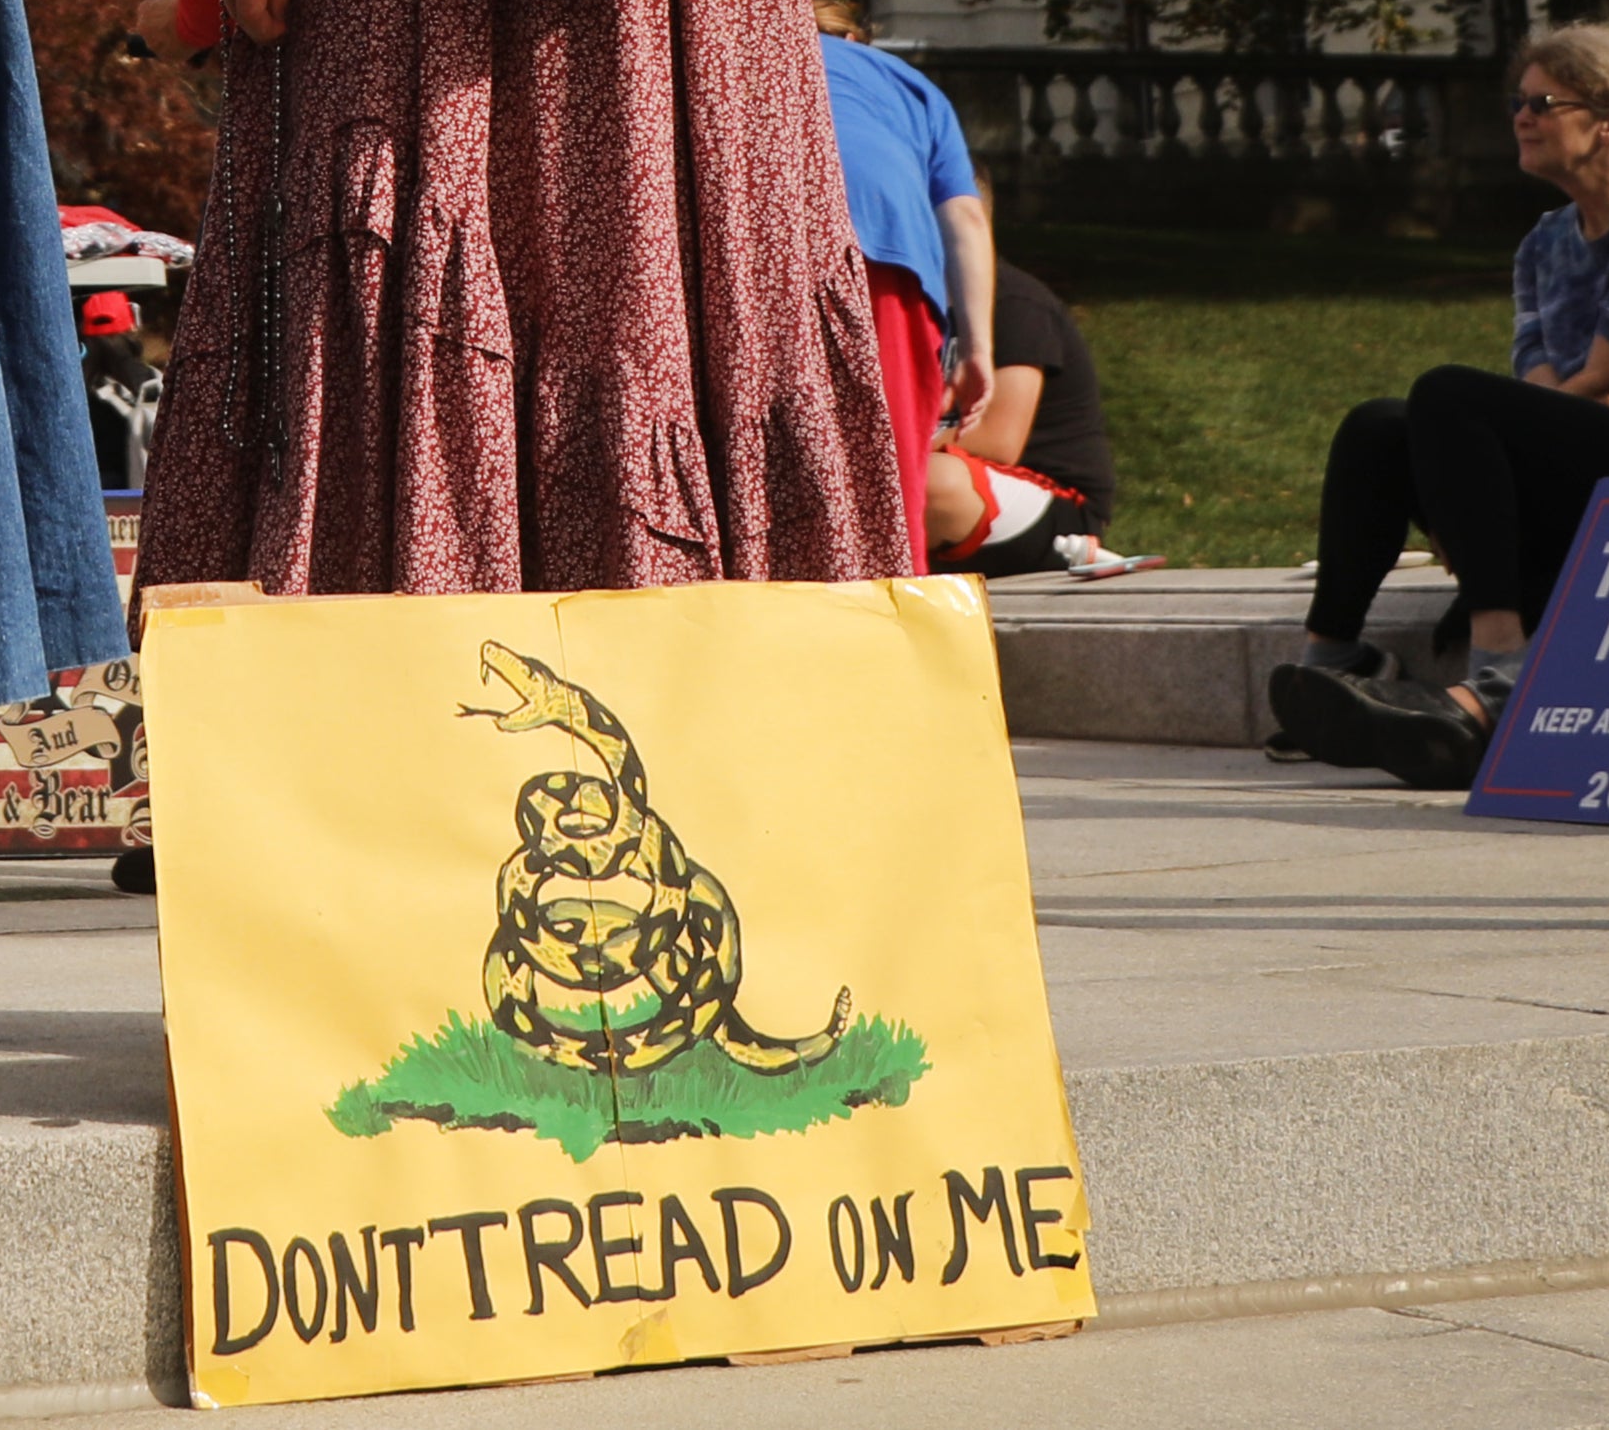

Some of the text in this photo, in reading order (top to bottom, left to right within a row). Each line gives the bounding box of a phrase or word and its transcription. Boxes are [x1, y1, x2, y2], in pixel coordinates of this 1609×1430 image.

[29, 721, 79, 762] And
[1530, 707, 1594, 734] KEEP
[3, 785, 21, 823] &
[30, 770, 114, 838] Bear
[428, 1186, 791, 1319] TREAD
[828, 1191, 914, 1293] ON
[941, 1166, 1082, 1285] ME
